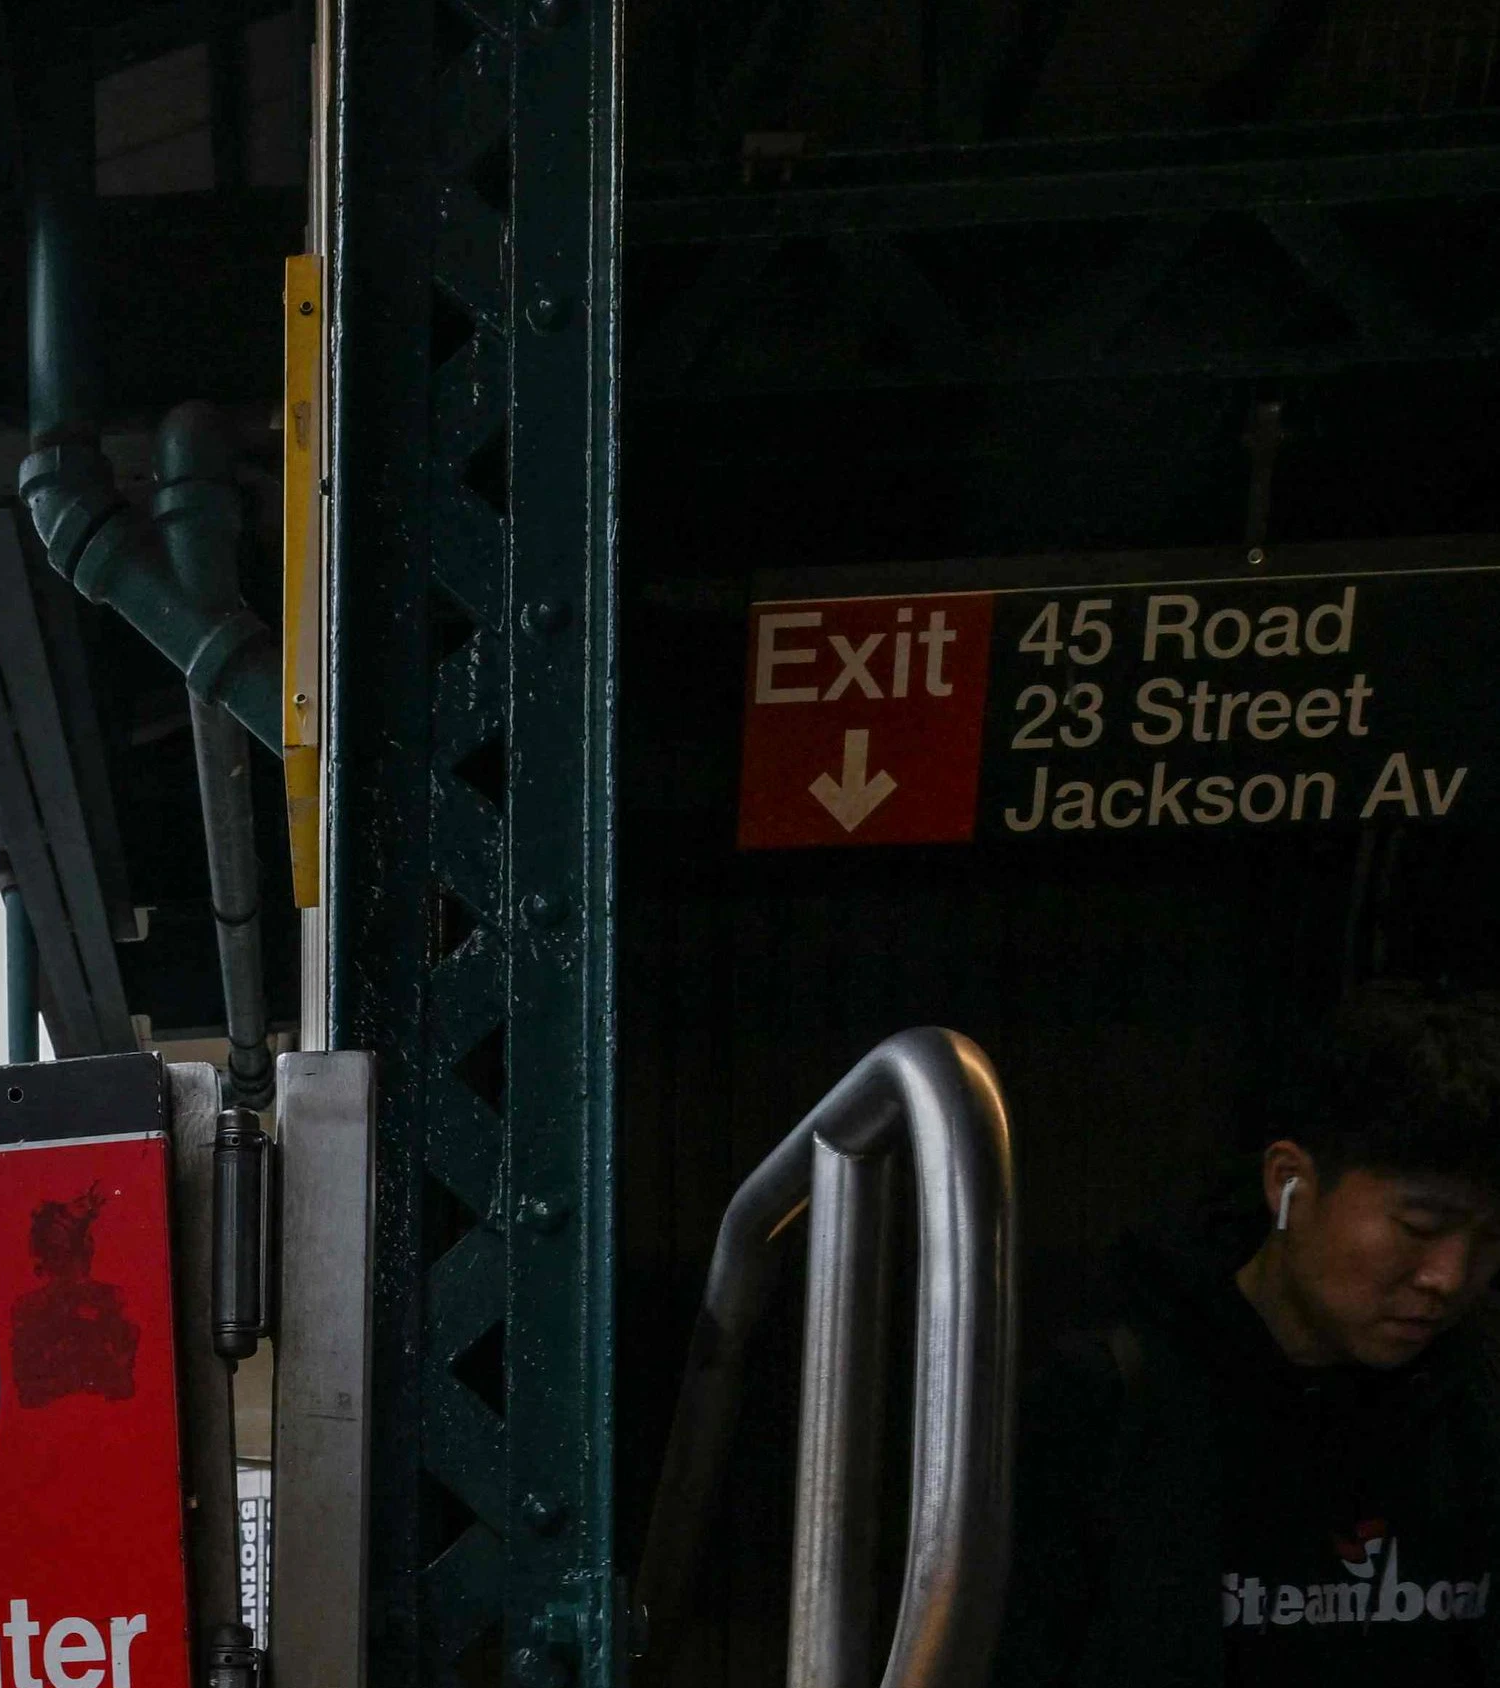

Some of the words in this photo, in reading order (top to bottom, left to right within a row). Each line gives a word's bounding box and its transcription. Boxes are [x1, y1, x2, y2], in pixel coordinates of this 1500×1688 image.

[753, 606, 957, 706] Exit
[1017, 598, 1113, 667] 45
[1141, 586, 1358, 663] Road
[1010, 682, 1104, 750] 23
[1130, 673, 1376, 745] Street
[1003, 763, 1338, 834] Jackson
[1360, 751, 1469, 819] Av
[241, 1499, 257, 1648] 5POINT
